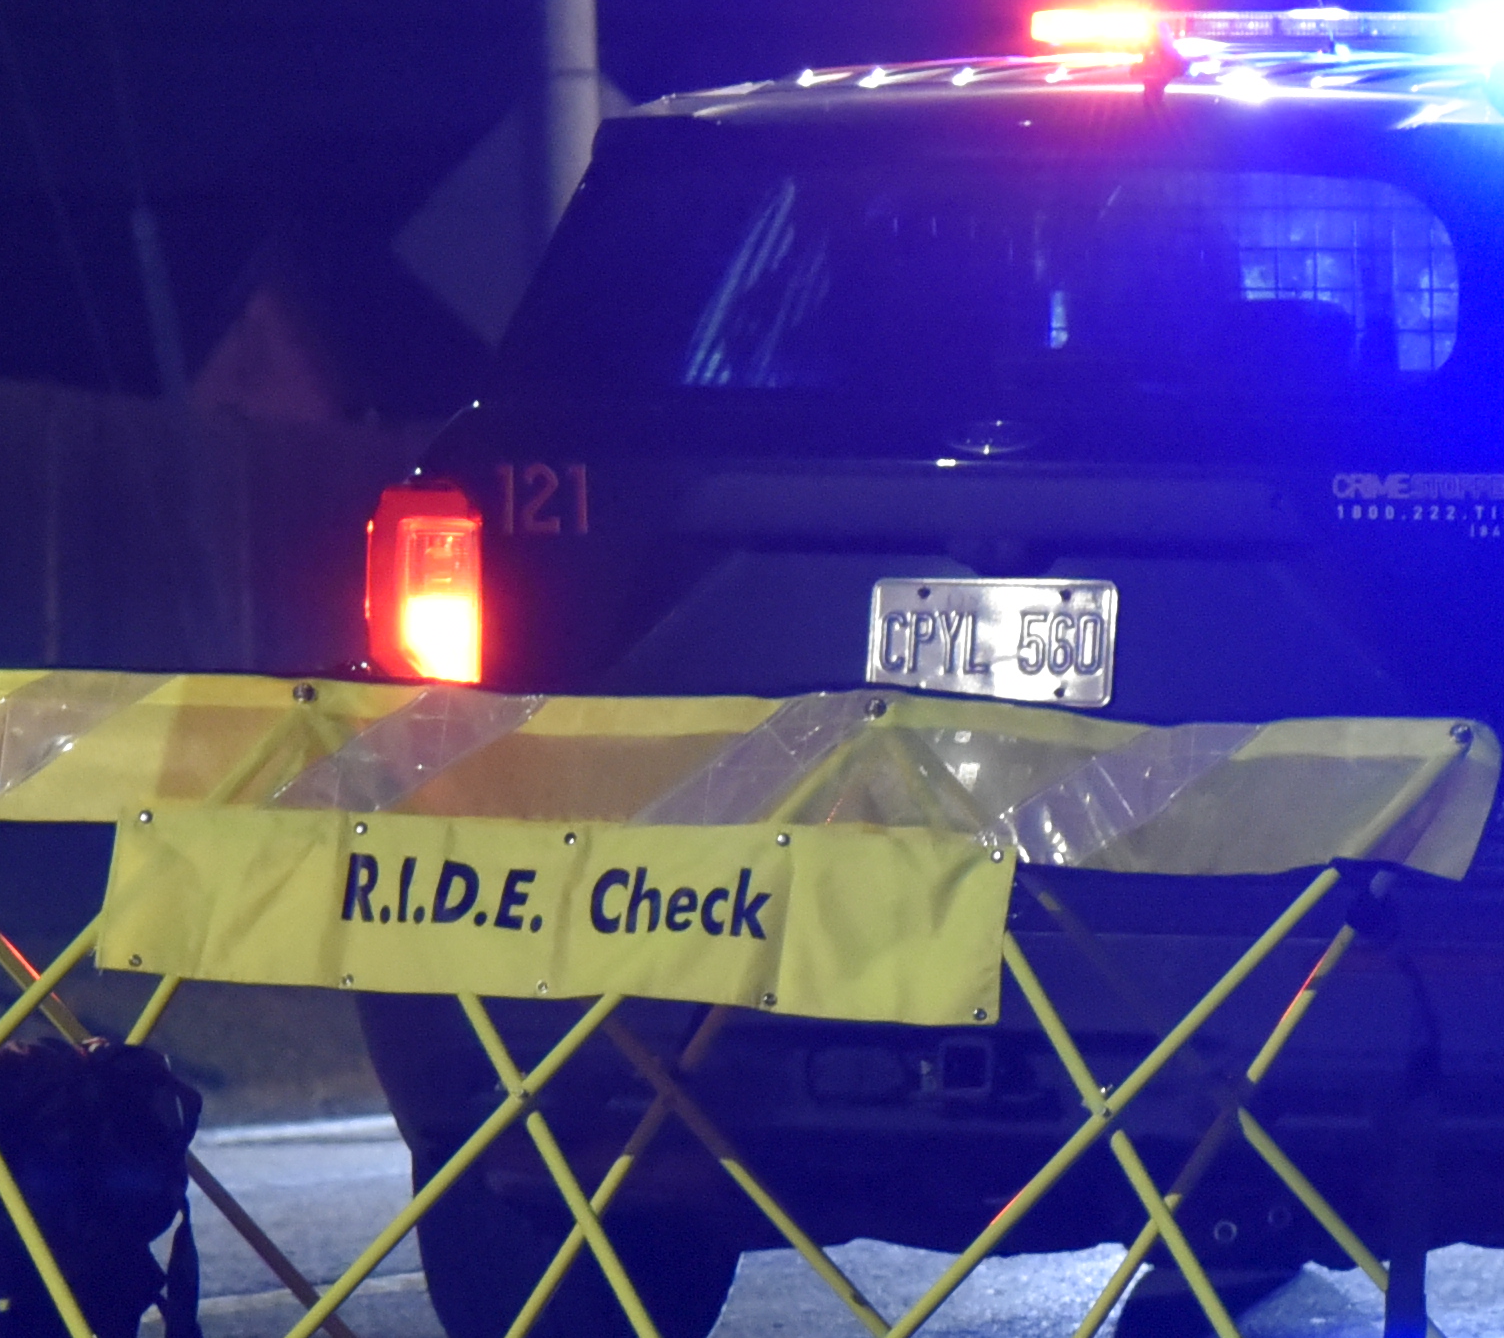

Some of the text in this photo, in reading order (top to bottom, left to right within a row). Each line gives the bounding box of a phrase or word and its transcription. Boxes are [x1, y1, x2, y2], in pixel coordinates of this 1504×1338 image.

[496, 462, 588, 533] 121
[879, 610, 1104, 675] CPYL 560
[341, 852, 772, 940] R.I.D.E. Check
